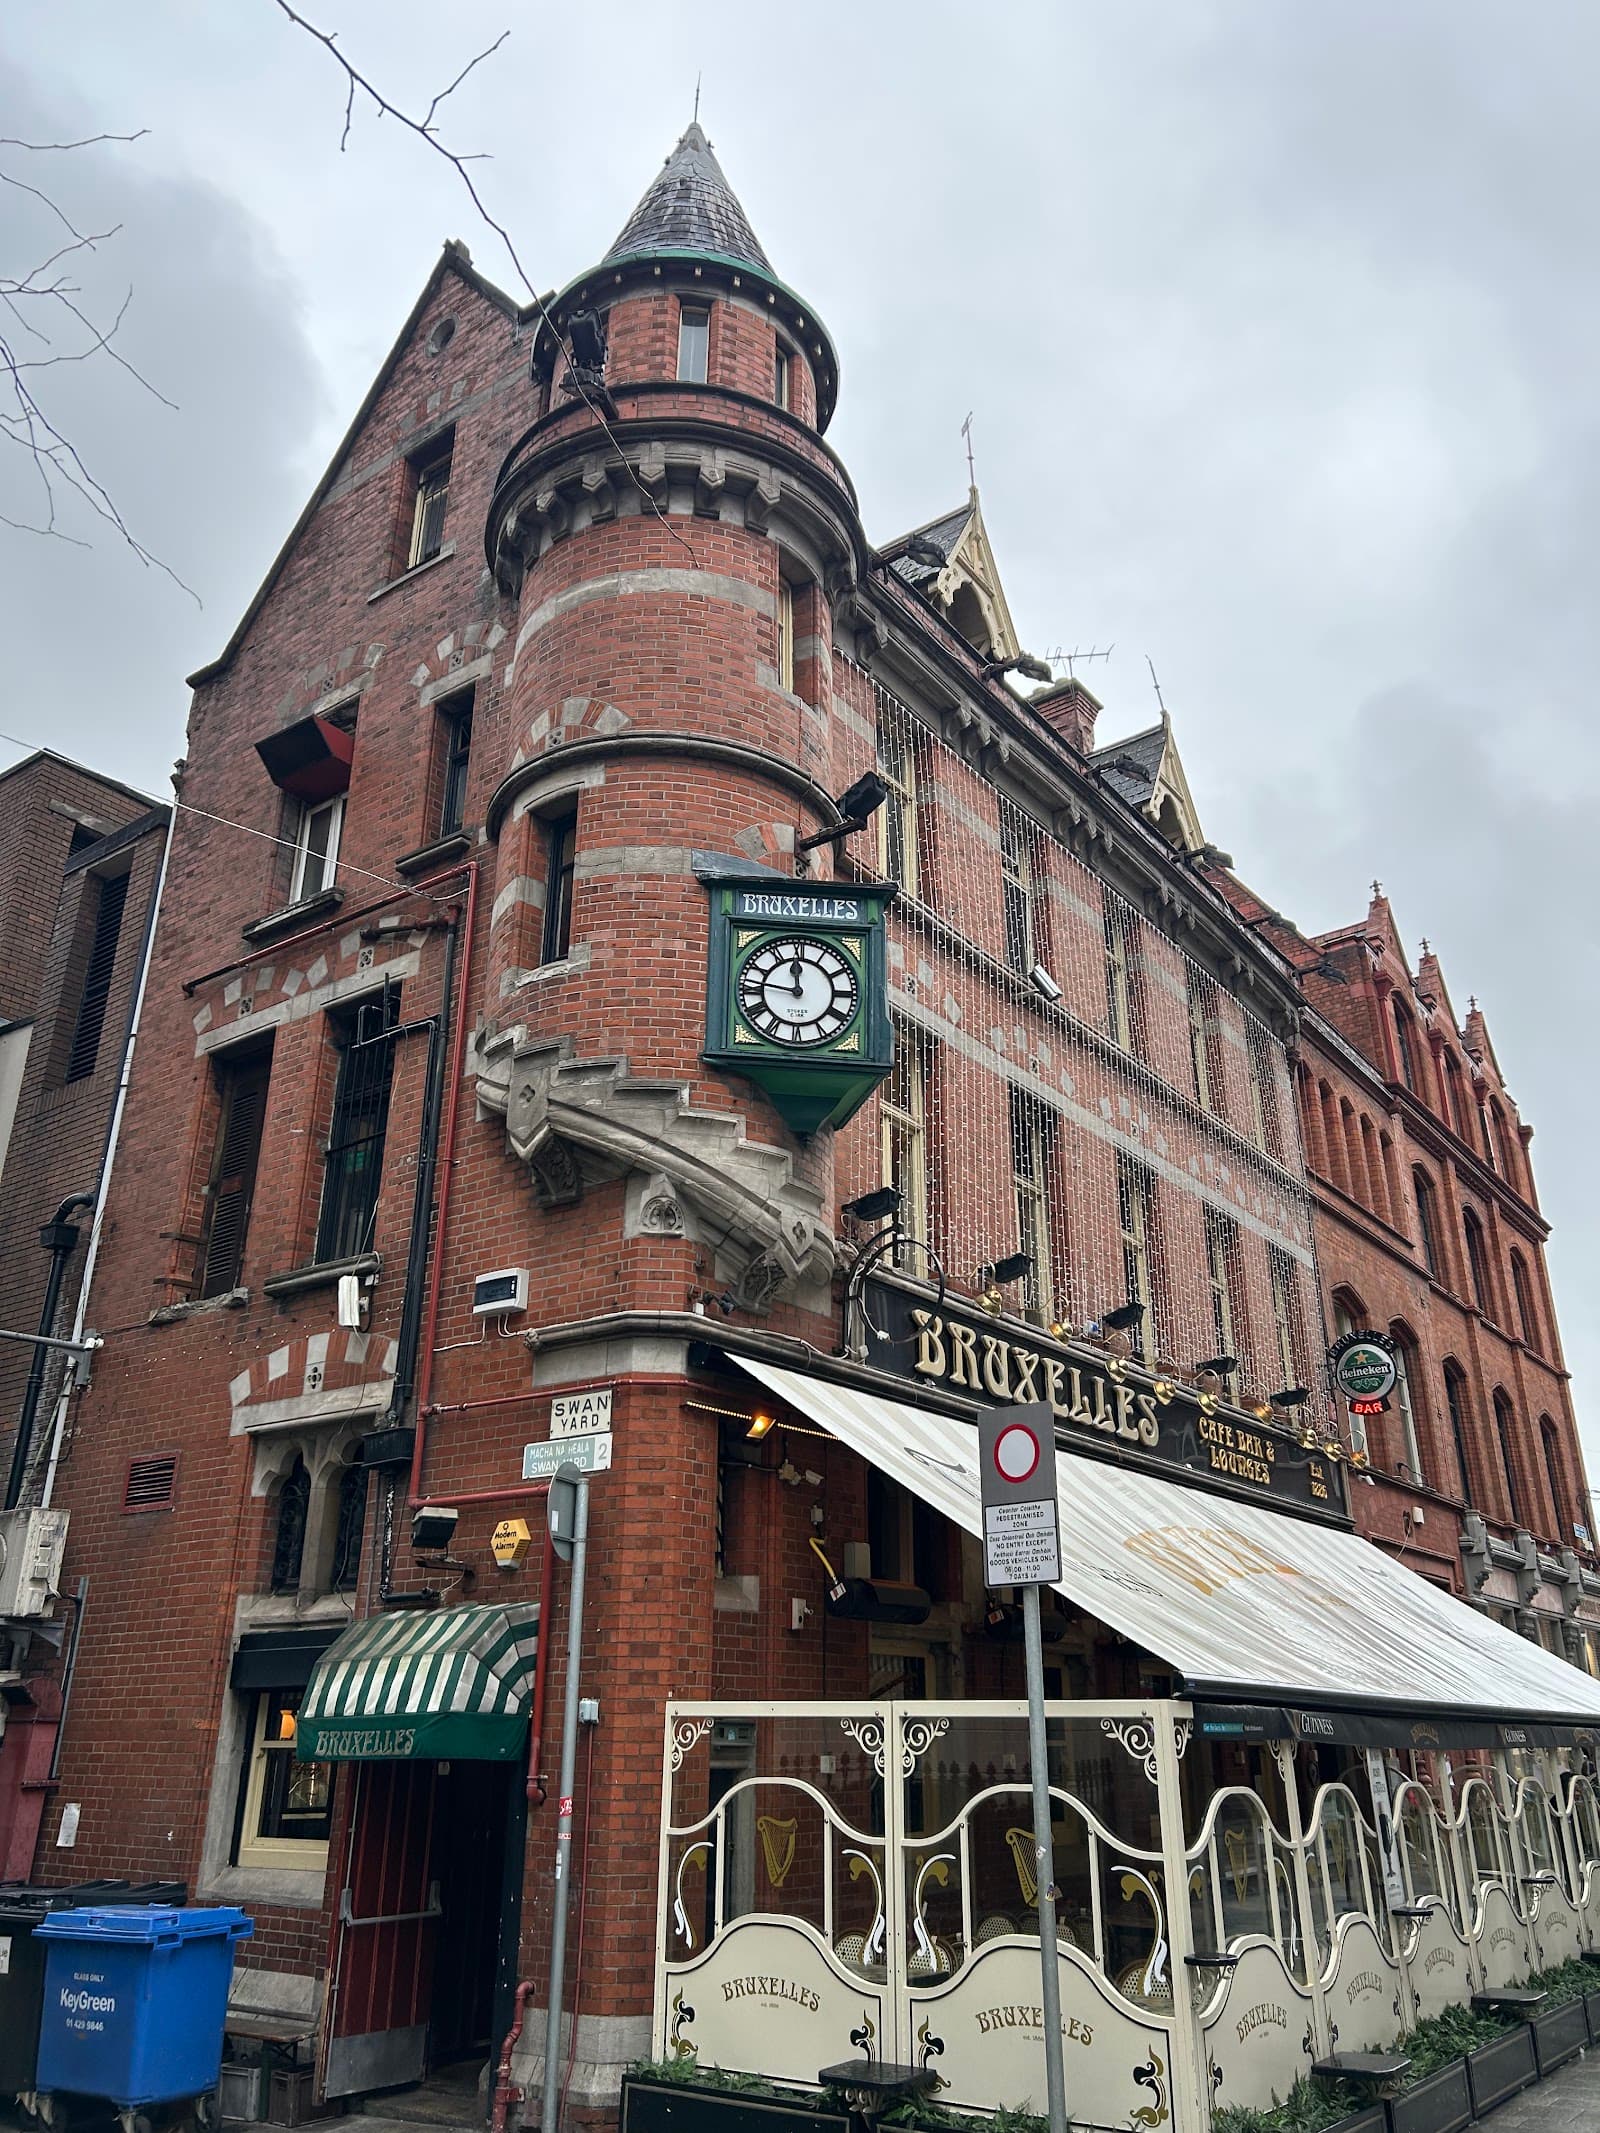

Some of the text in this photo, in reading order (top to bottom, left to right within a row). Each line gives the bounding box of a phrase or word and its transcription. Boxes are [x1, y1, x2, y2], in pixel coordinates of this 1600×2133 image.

[743, 893, 859, 920] BRUXELLES
[911, 1309, 1160, 1447] BRUXELLES
[1340, 1364, 1389, 1380] Heineken
[554, 1395, 609, 1417] SWAN
[1354, 1402, 1384, 1414] BAR
[561, 1413, 599, 1432] YARD
[598, 1442, 608, 1461] 2
[1199, 1417, 1275, 1463] CAFE BAR &
[531, 1460, 559, 1474] SWAN
[1209, 1445, 1272, 1485] LOUNGES
[1006, 1541, 1024, 1549] ENTRY
[1025, 1539, 1048, 1547] EXCEPT
[1010, 1556, 1039, 1565] VEHICLES
[1040, 1554, 1056, 1562] ONLY
[1301, 1713, 1334, 1736] GUINNESS
[314, 1729, 417, 1757] BRUXELLES
[60, 1988, 116, 2013] KeyGreen
[721, 1975, 821, 2012] BRUXELLES
[1236, 2003, 1288, 2044] BRUXELLES
